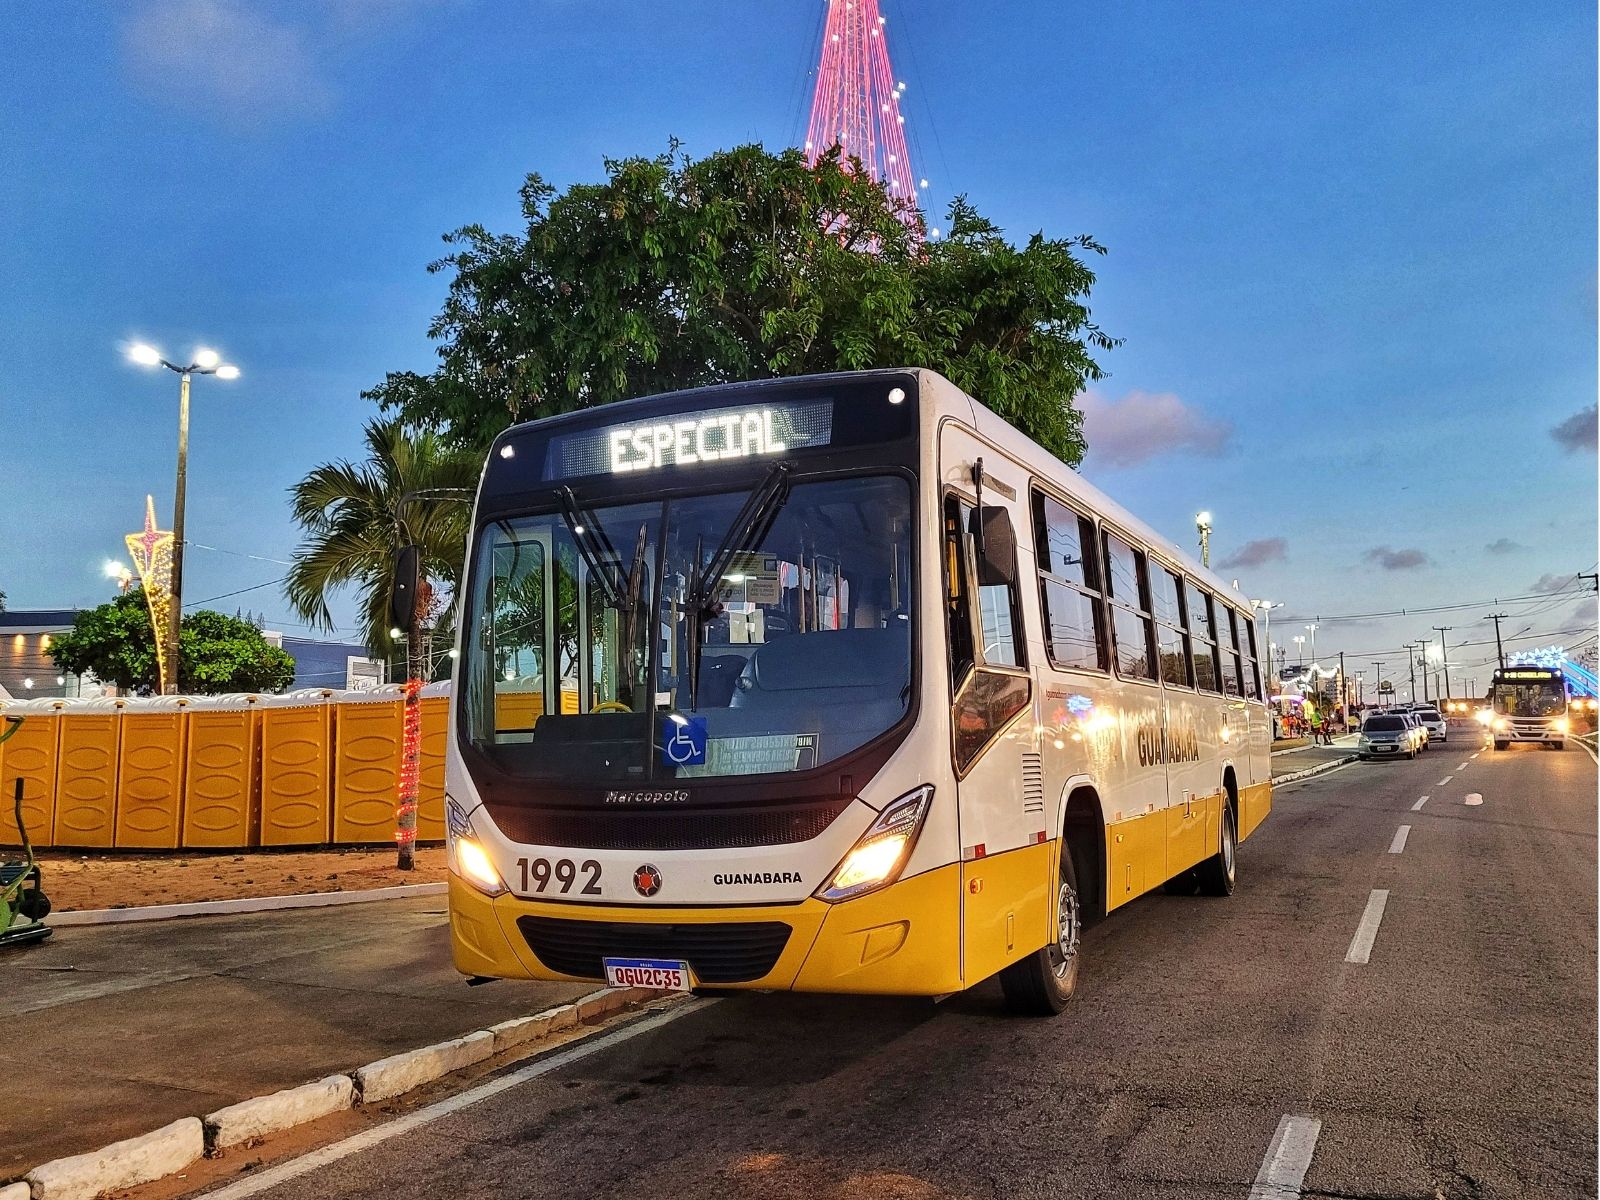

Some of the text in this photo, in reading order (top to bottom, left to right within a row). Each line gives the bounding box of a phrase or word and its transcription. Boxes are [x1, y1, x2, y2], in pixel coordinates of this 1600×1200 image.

[610, 410, 786, 472] ESPECIAL
[1137, 726, 1199, 767] GUANABARA
[606, 790, 688, 803] Marcopolo
[516, 857, 602, 894] 1992
[713, 871, 803, 886] GUANABARA
[615, 967, 682, 988] QGU2C35
